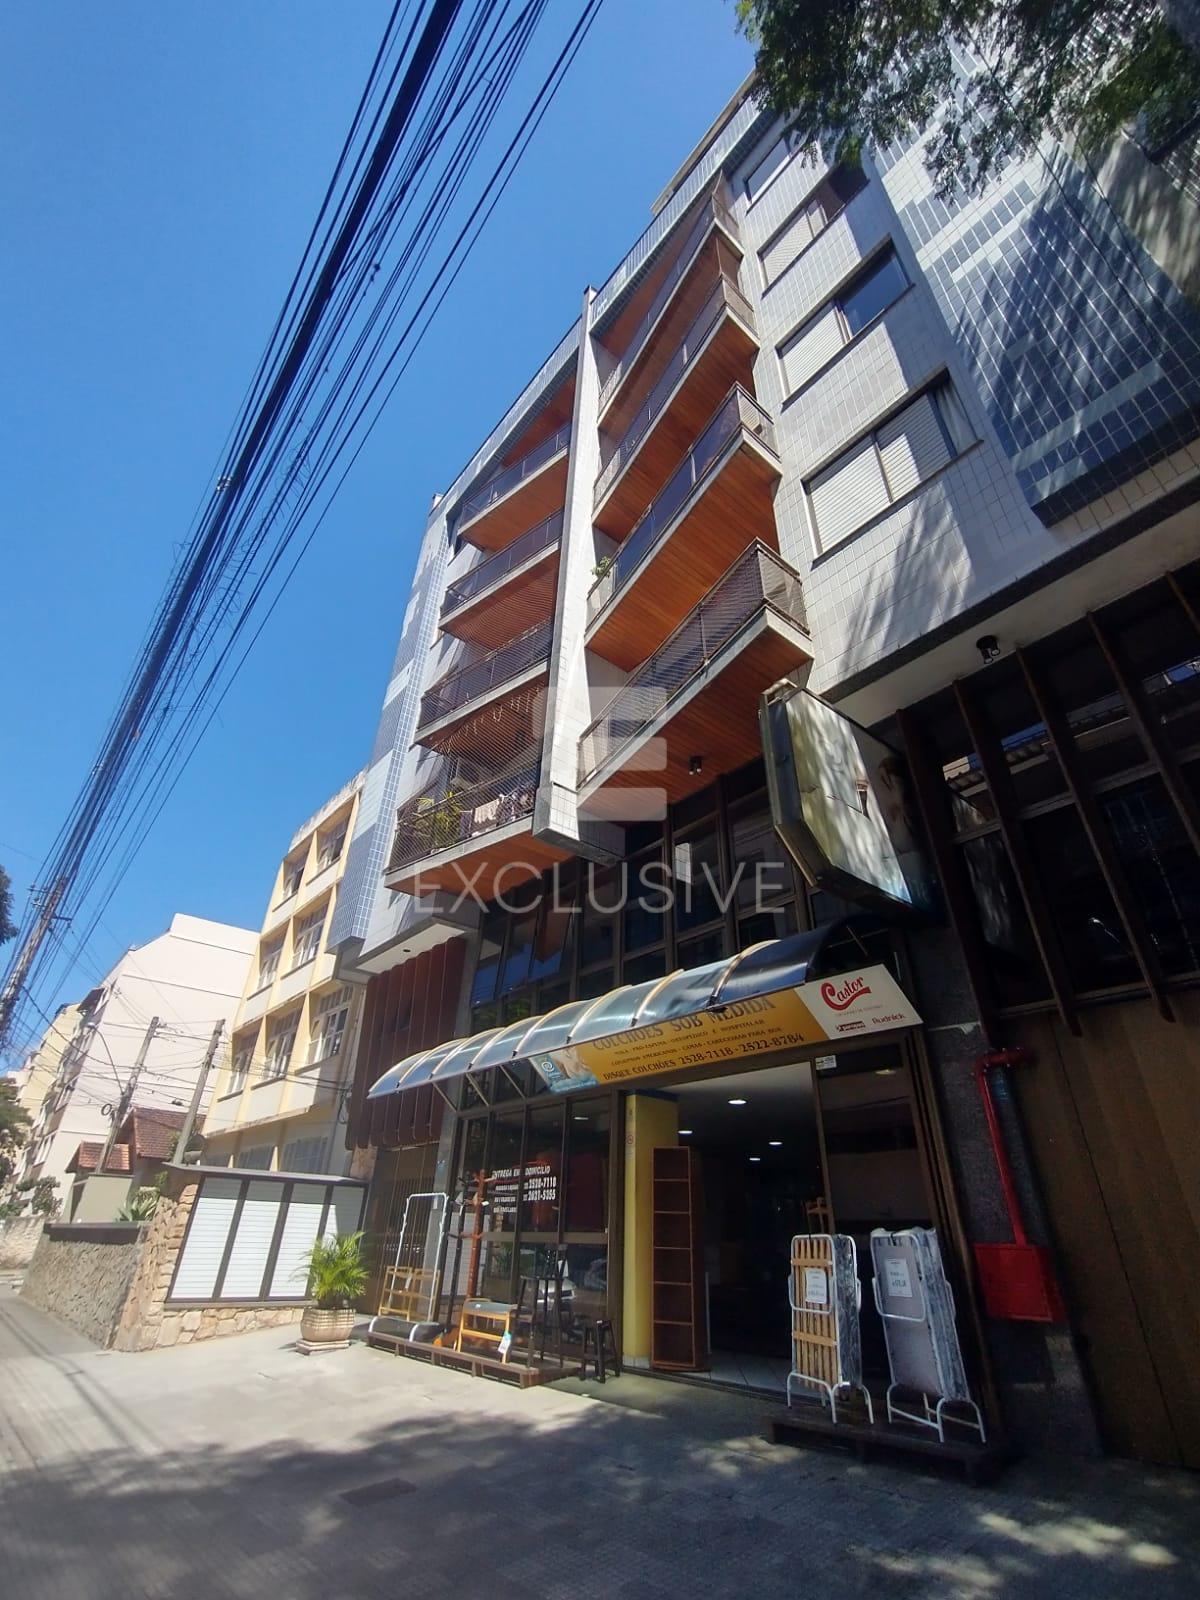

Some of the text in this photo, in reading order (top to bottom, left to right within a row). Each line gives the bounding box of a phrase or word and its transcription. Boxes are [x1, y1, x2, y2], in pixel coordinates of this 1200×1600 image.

[821, 976, 872, 1011] Castor
[670, 1015, 702, 1032] SOB
[708, 996, 776, 1024] MEDIDA
[602, 1069, 631, 1080] DISQUE
